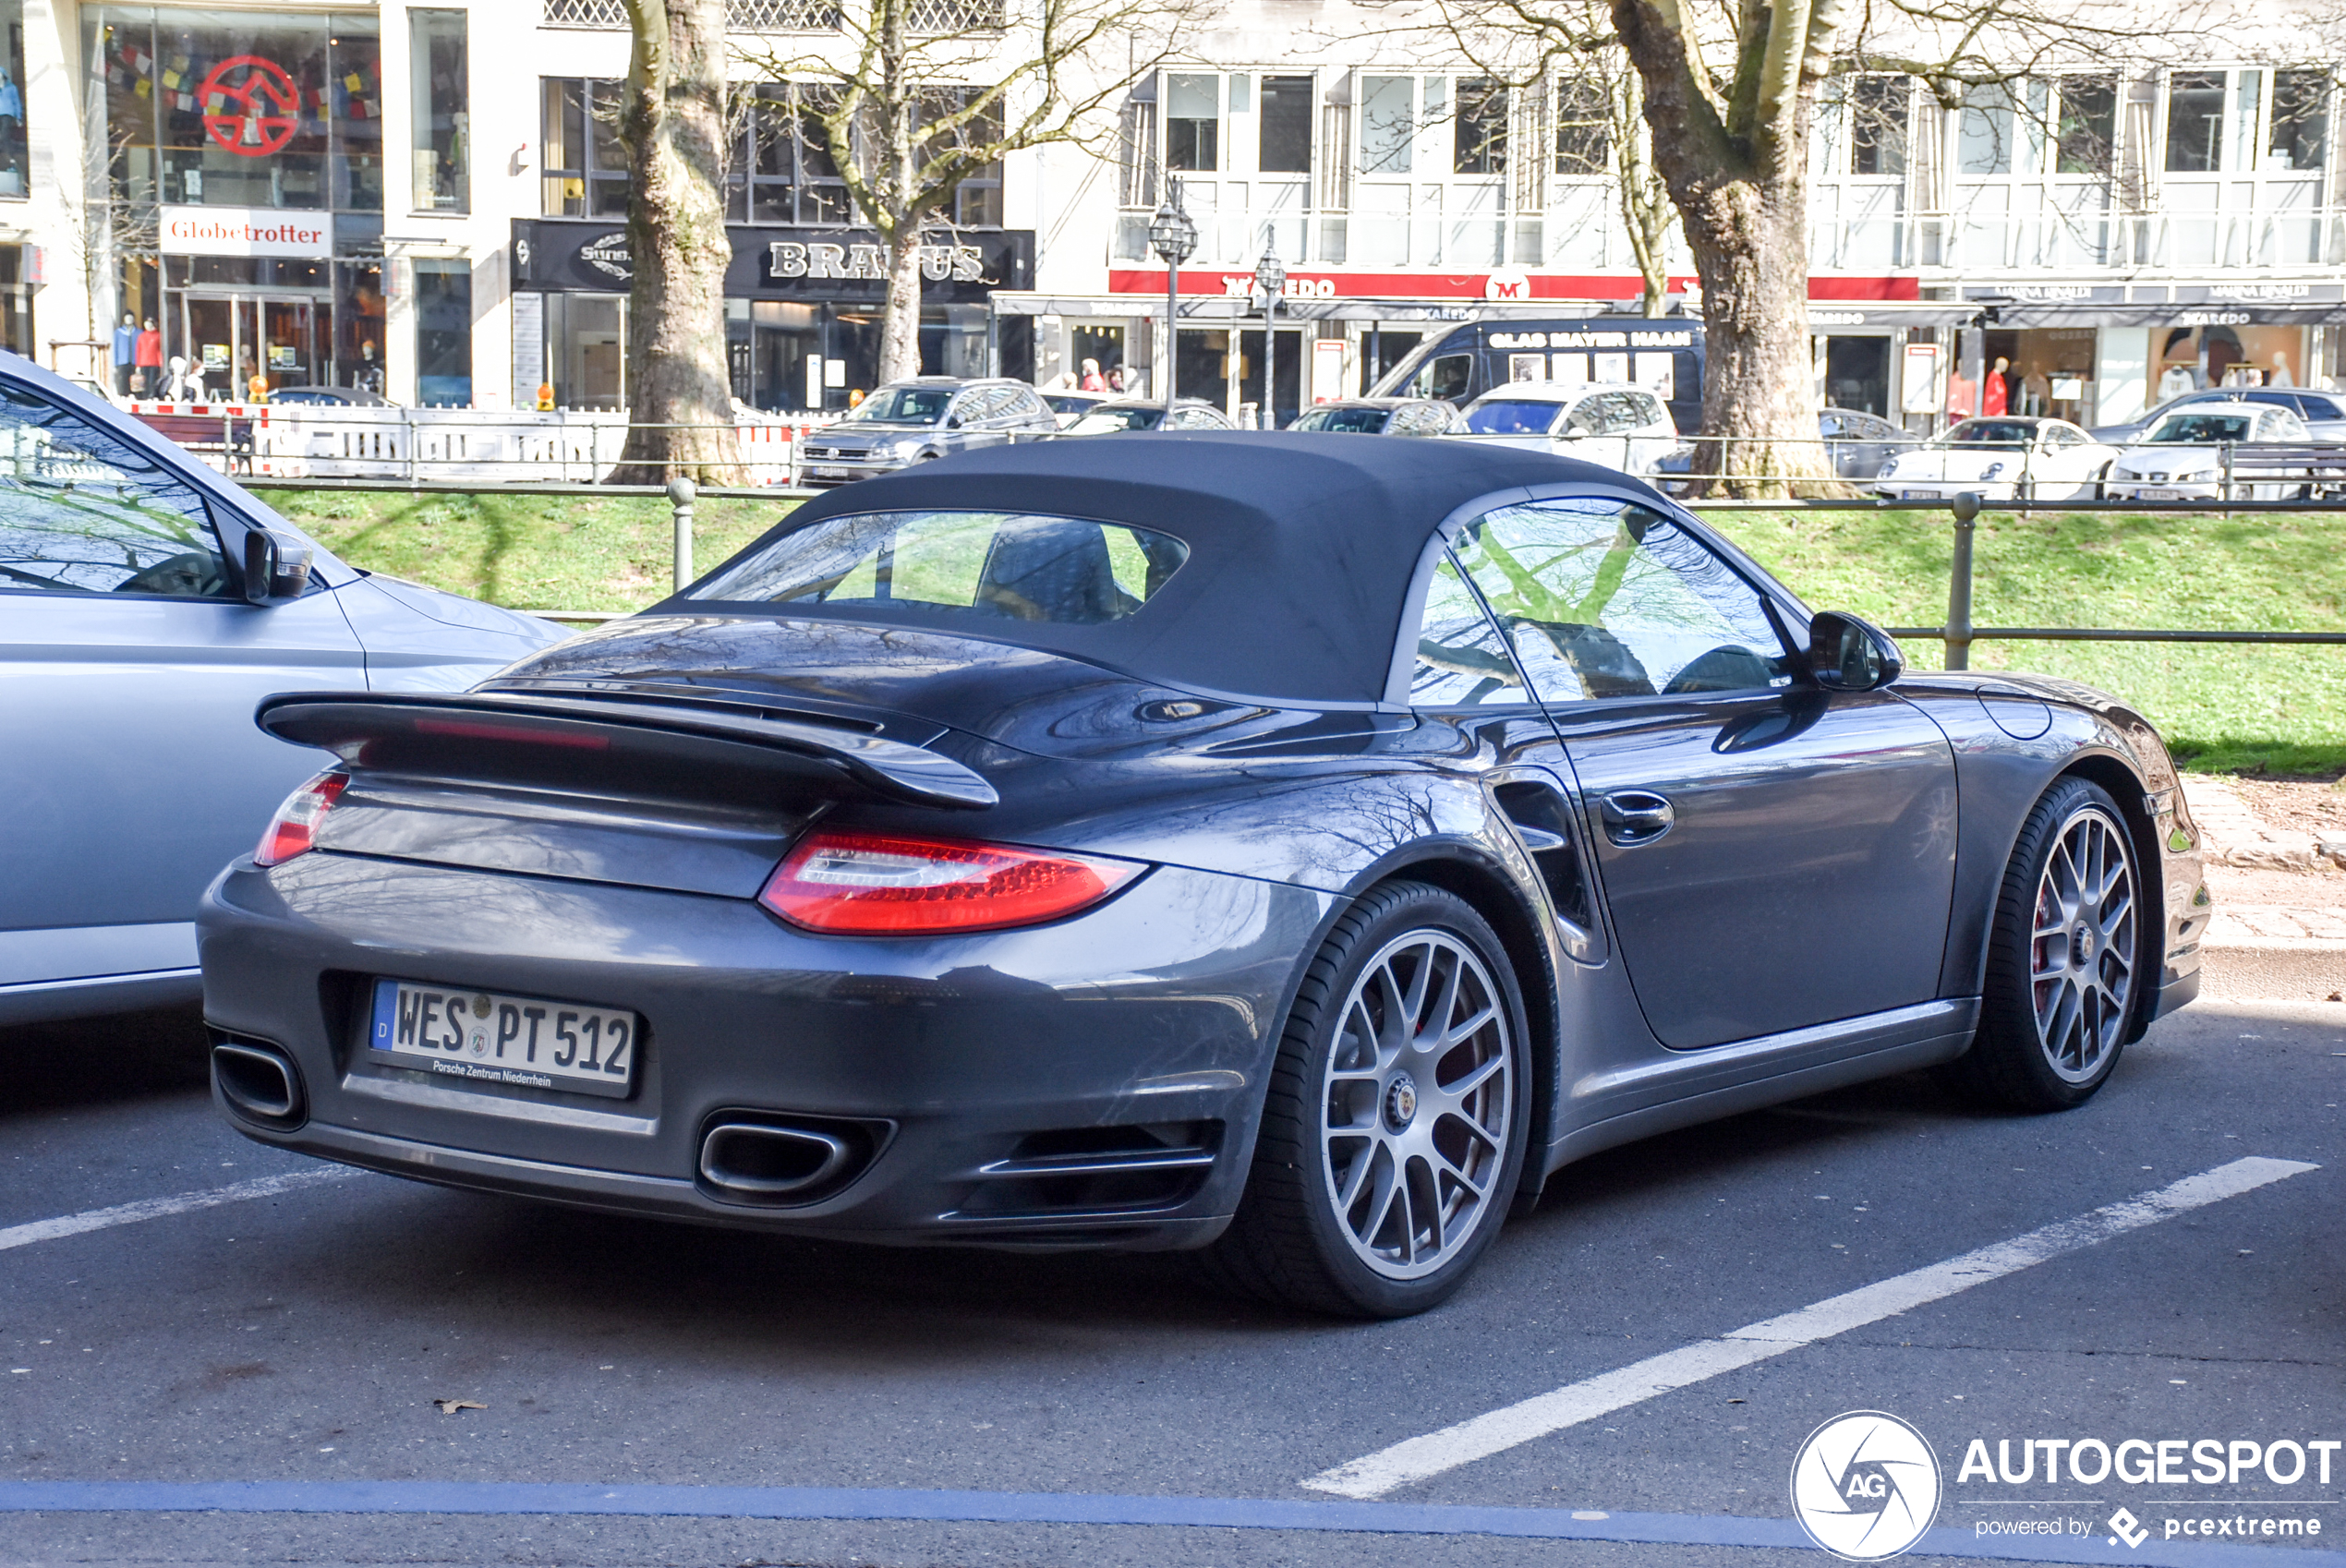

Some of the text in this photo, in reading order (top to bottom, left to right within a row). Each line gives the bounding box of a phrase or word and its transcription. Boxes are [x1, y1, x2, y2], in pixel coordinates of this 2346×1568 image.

[172, 221, 322, 244] Globetrotter
[769, 241, 984, 282] BRAUS
[2182, 311, 2251, 325] MAREDO
[1489, 332, 1692, 349] GLAS MAYER HAAN
[378, 989, 629, 1075] D WES PT 512
[432, 1060, 551, 1088] Porsche Zentrum Niederrhein
